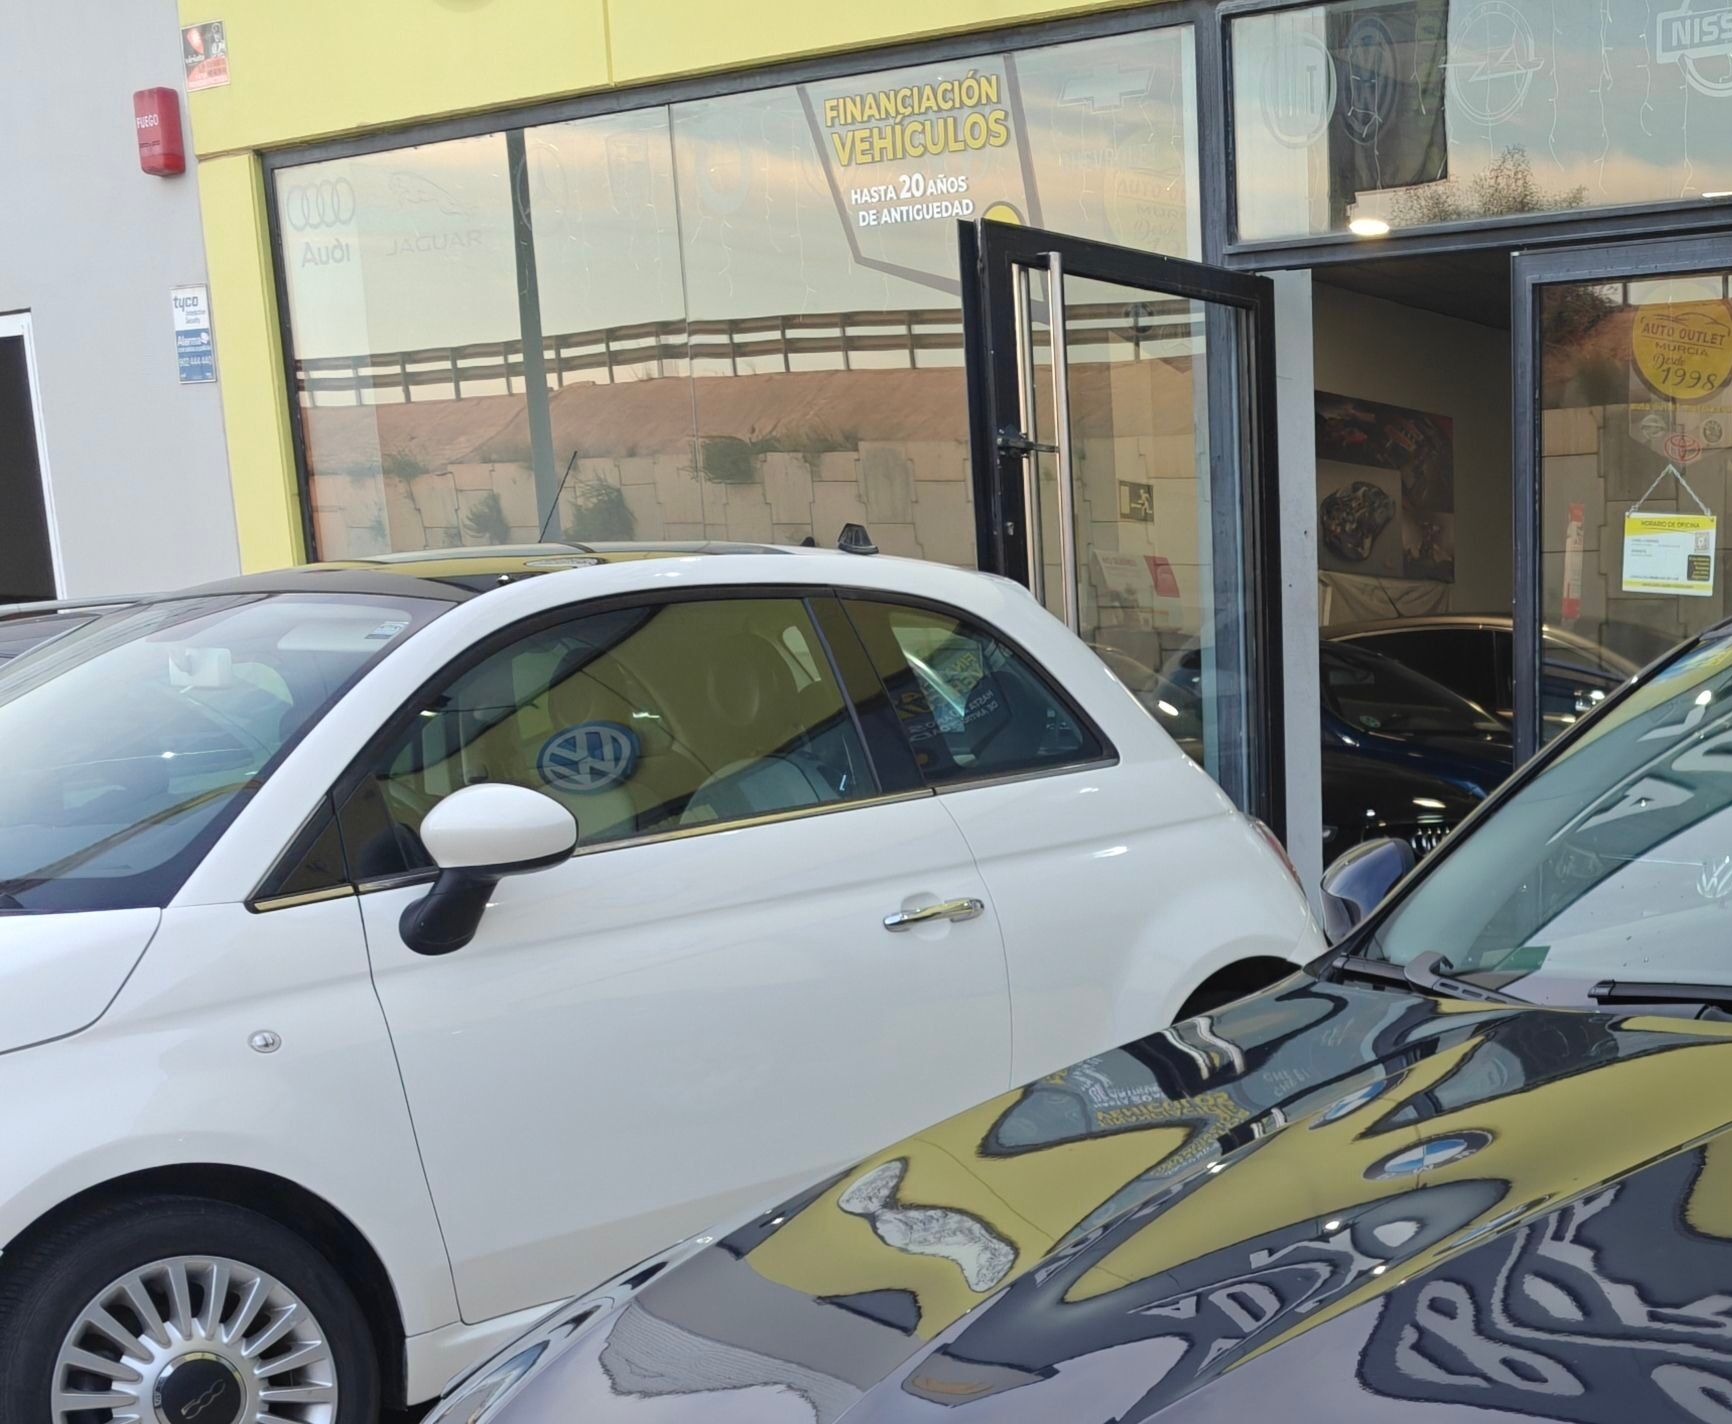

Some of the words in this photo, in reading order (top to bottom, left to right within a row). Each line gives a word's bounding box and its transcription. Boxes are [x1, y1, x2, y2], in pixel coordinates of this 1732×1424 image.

[823, 69, 999, 128] FINANCIACIÓN
[136, 114, 160, 129] FUEGO
[831, 110, 1009, 167] VEHÍCULOS
[850, 184, 898, 206] HASTA
[898, 173, 925, 200] 20
[926, 174, 968, 197] AÑOS
[858, 210, 878, 227] DE
[880, 199, 974, 226] ANTIGUEDAD
[301, 238, 351, 268] Audi
[385, 230, 483, 257] JAGUAR
[172, 295, 199, 312] tyco
[1641, 322, 1675, 337] AUTO
[1678, 328, 1727, 346] OUTLET
[1654, 341, 1710, 357] MURCIA
[1660, 367, 1719, 391] 1998
